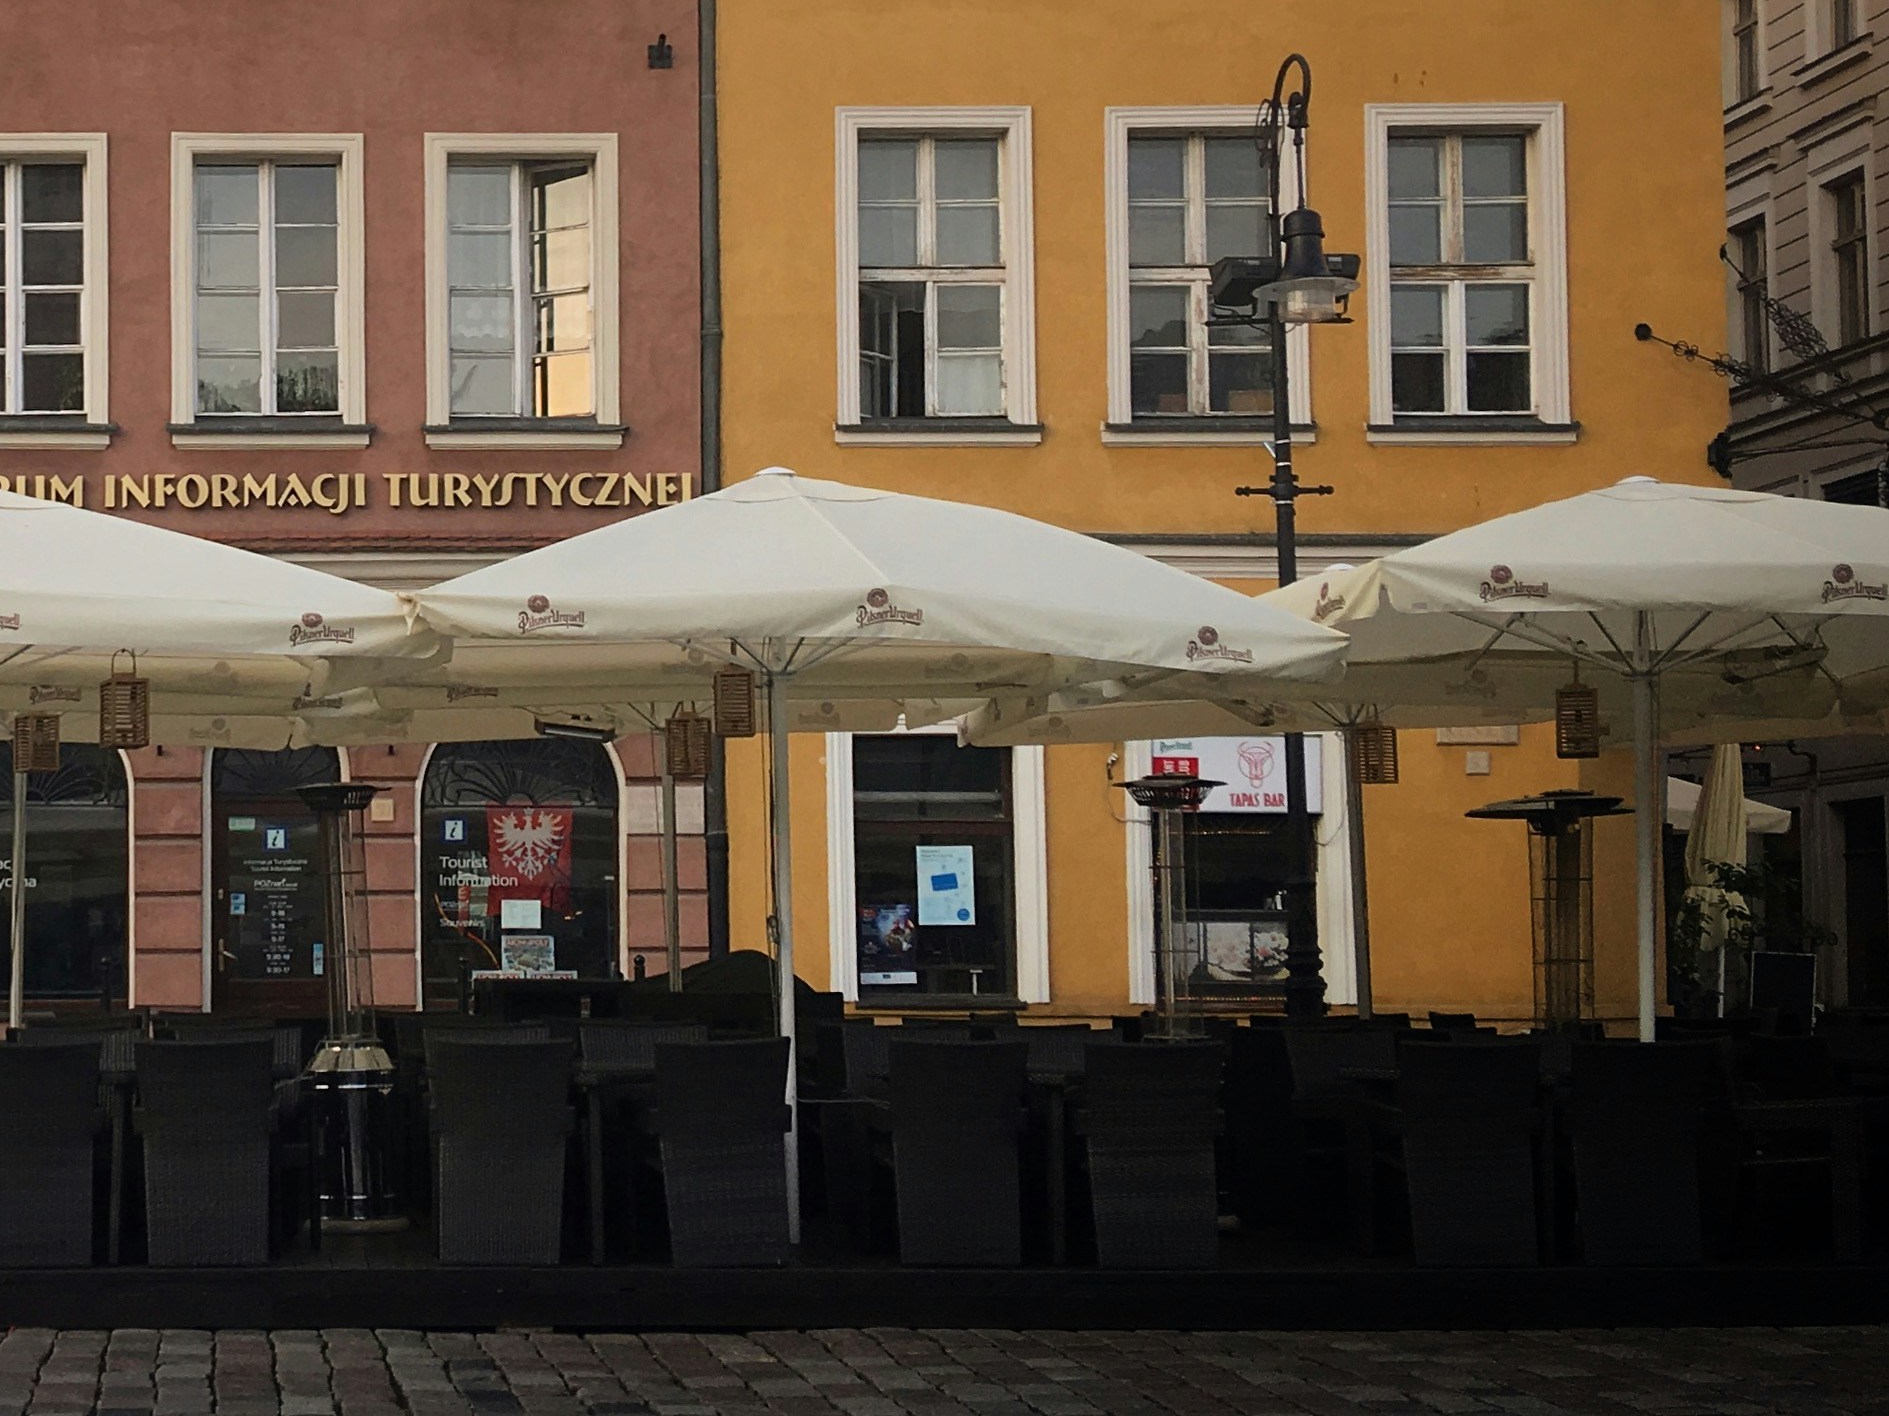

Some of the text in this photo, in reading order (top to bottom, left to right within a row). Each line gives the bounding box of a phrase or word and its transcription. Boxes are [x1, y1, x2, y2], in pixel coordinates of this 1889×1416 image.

[104, 472, 366, 514] INFORMACJI
[517, 609, 585, 634] Pilsner Urquell
[856, 605, 923, 628] Pilsner Urquell
[289, 624, 355, 646] Pilsner Urquell
[1229, 793, 1286, 807] TAPAS BAR
[438, 855, 488, 869] Tourist
[438, 873, 519, 887] Information
